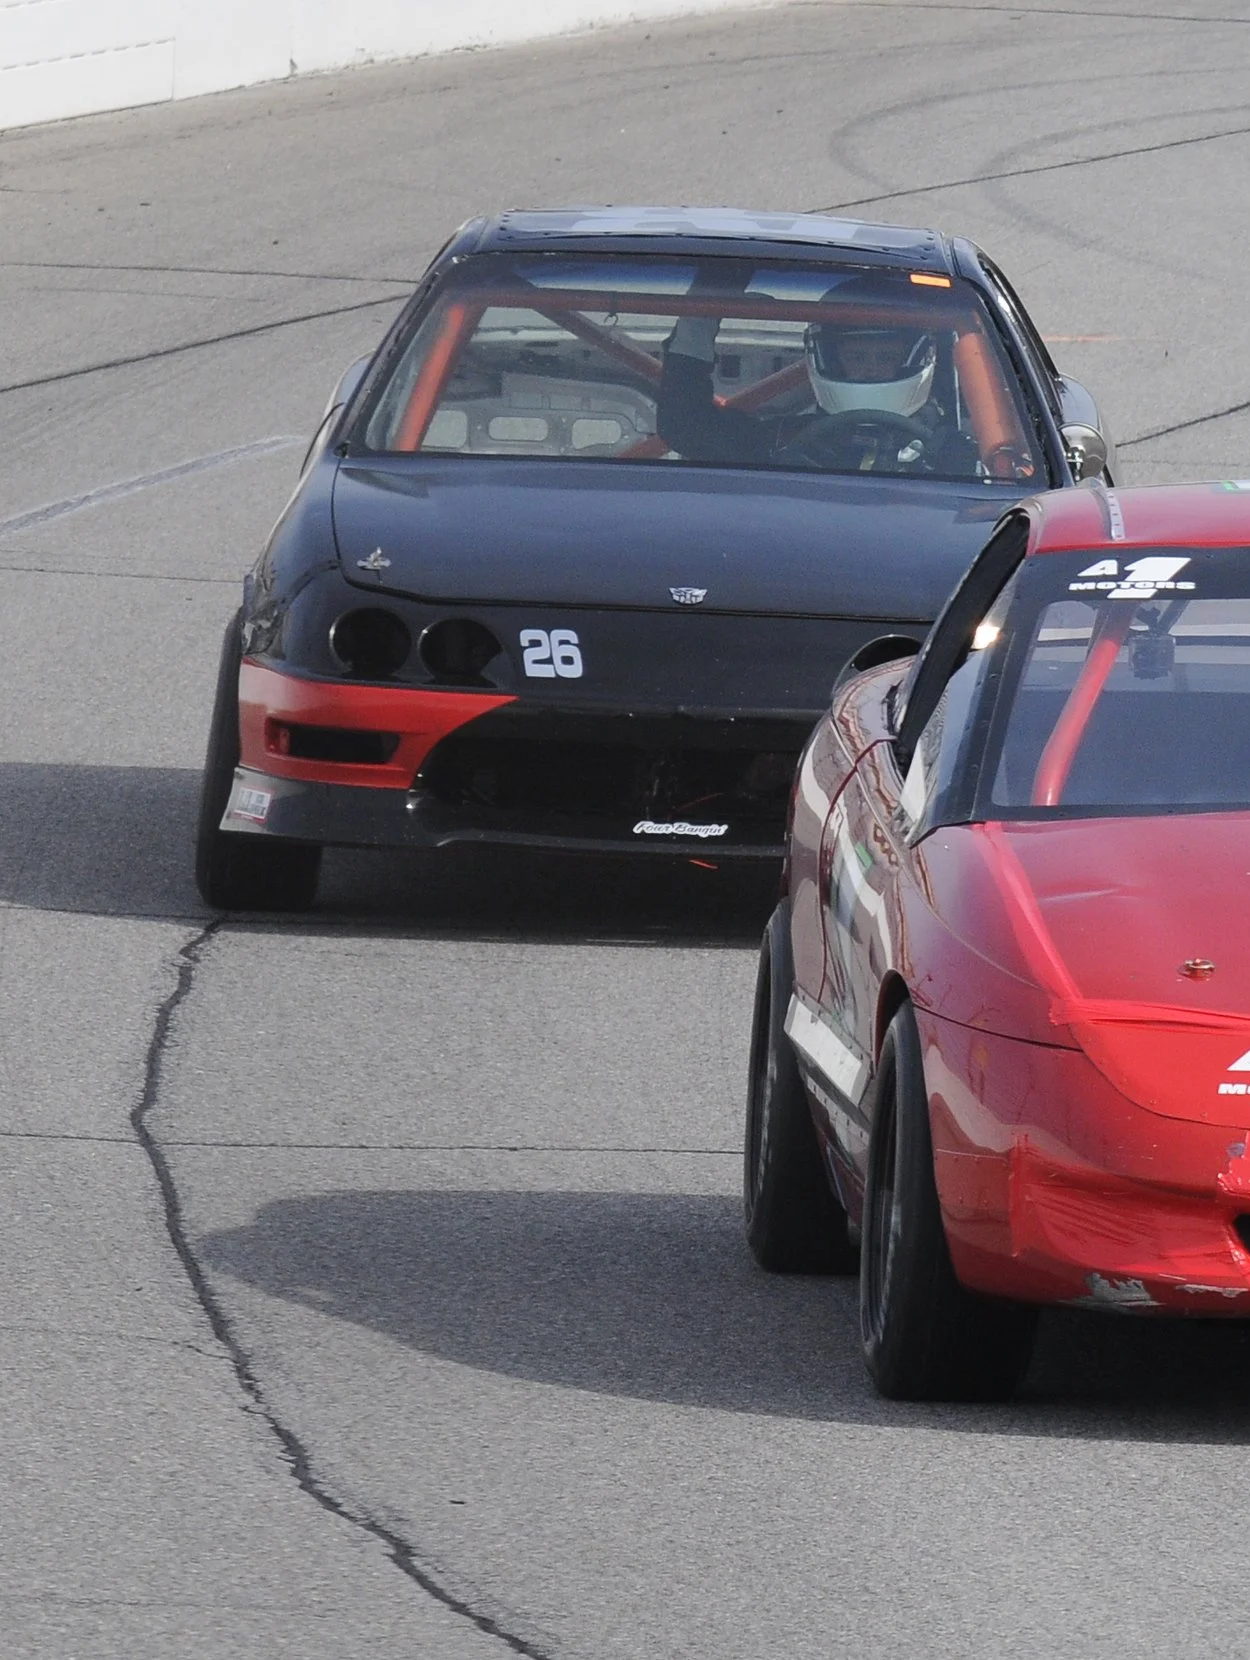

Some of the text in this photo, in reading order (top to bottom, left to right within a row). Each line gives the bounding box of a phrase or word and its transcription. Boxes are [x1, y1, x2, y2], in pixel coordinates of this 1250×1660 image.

[1068, 581, 1196, 591] MOTORS
[519, 629, 583, 678] 26
[633, 821, 673, 834] Four
